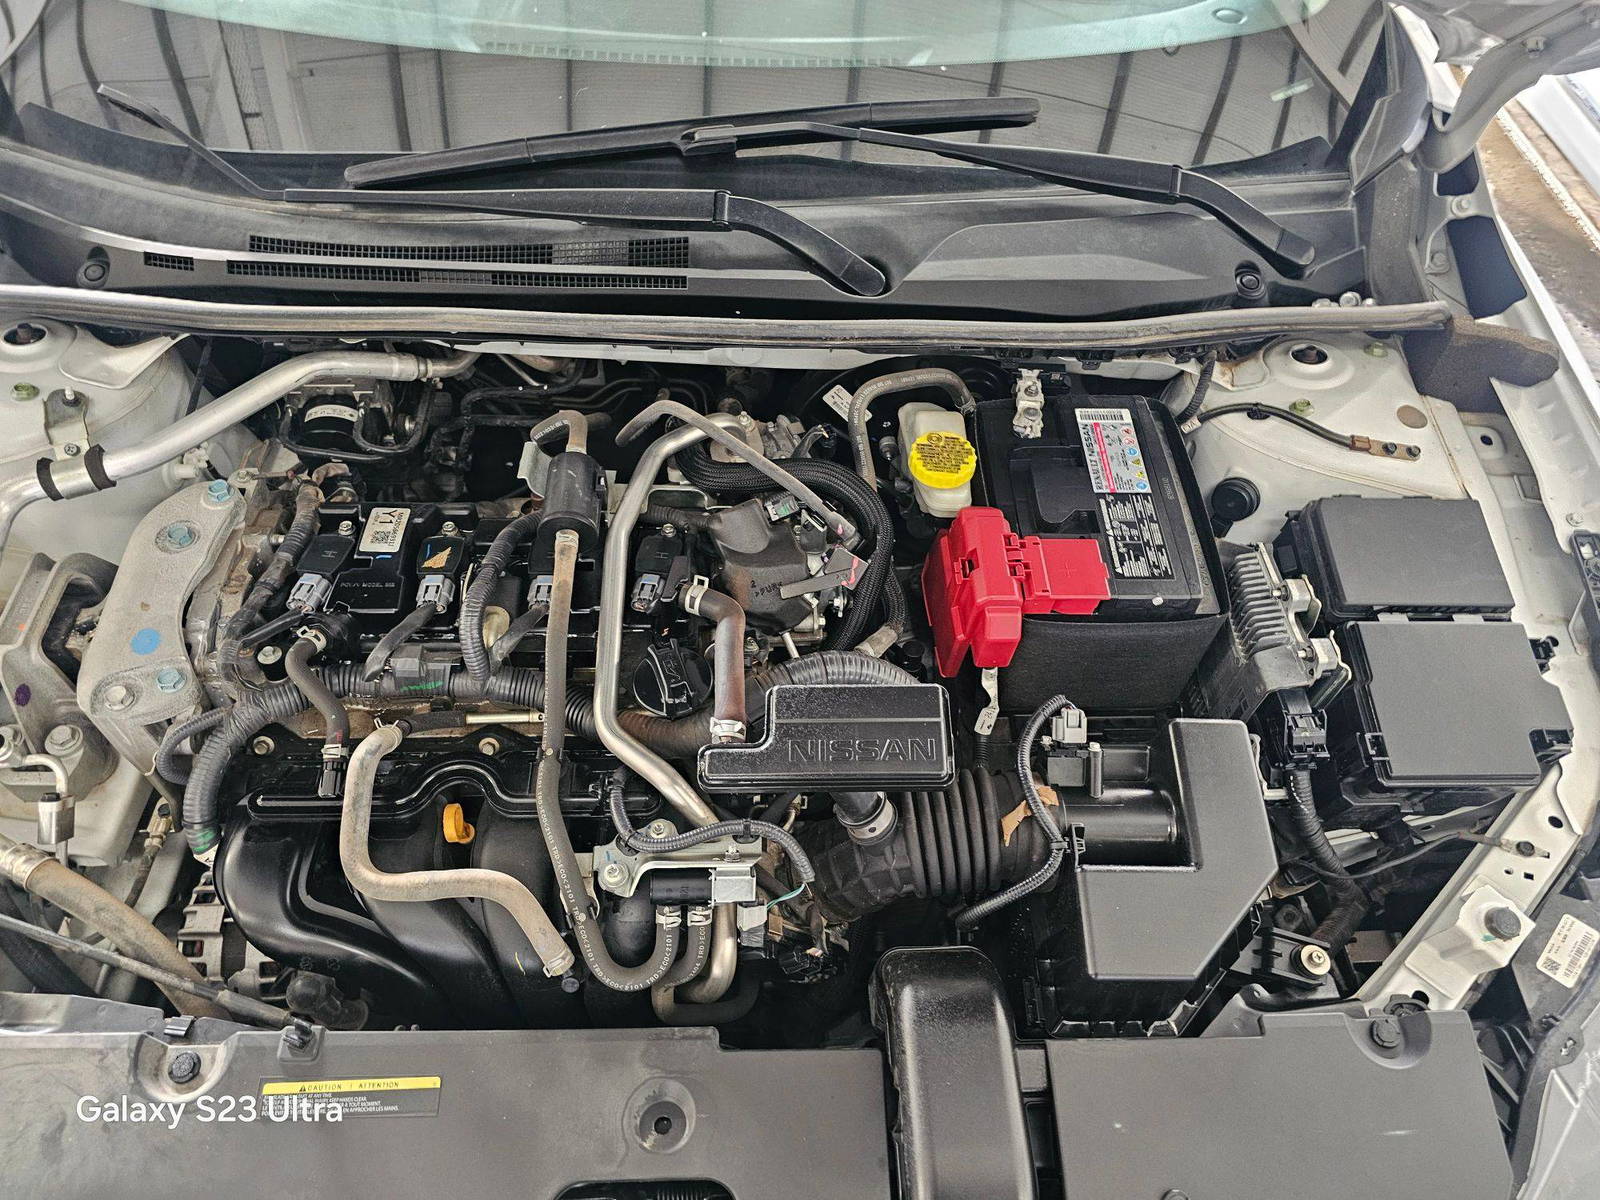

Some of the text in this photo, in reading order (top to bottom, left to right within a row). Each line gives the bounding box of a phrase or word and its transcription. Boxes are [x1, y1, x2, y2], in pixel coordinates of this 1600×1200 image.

[1081, 423, 1095, 457] NISSAN
[787, 738, 937, 762] NISSAN
[307, 1080, 400, 1092] CAUTION ATTENTION
